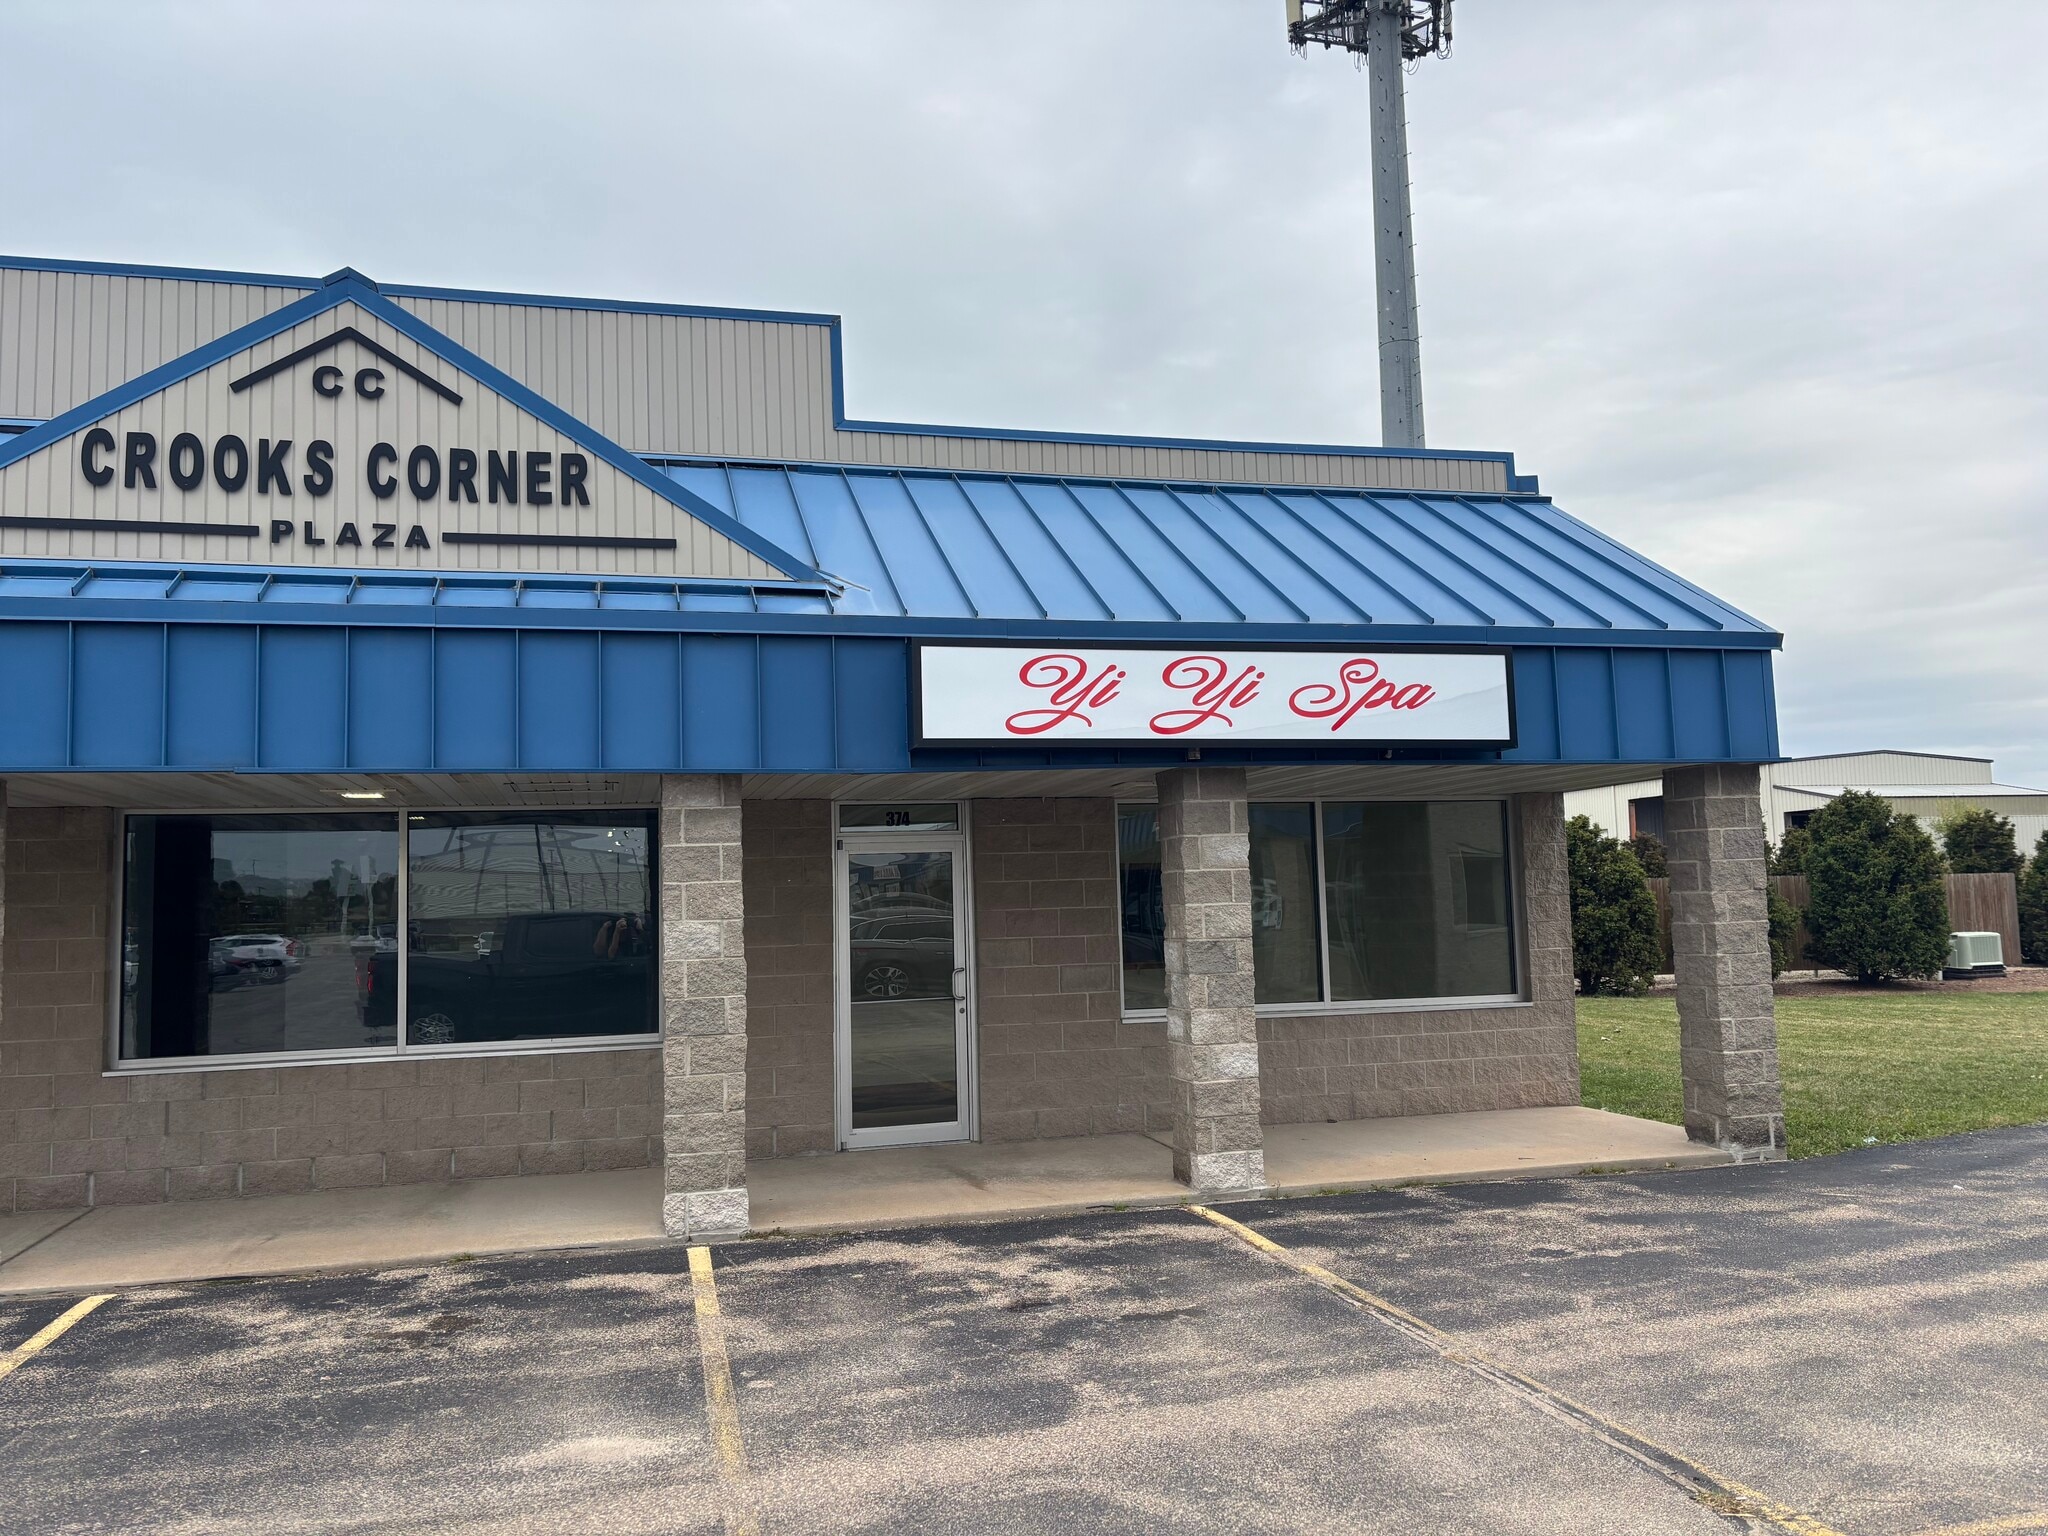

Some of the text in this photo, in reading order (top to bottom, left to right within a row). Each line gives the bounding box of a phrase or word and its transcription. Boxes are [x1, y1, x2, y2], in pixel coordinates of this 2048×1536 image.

[312, 365, 386, 400] CC
[81, 427, 590, 506] CROOKS CORNER
[271, 519, 431, 549] PLAZA
[1004, 653, 1436, 736] Yi Yi Spa
[886, 811, 910, 826] 374
